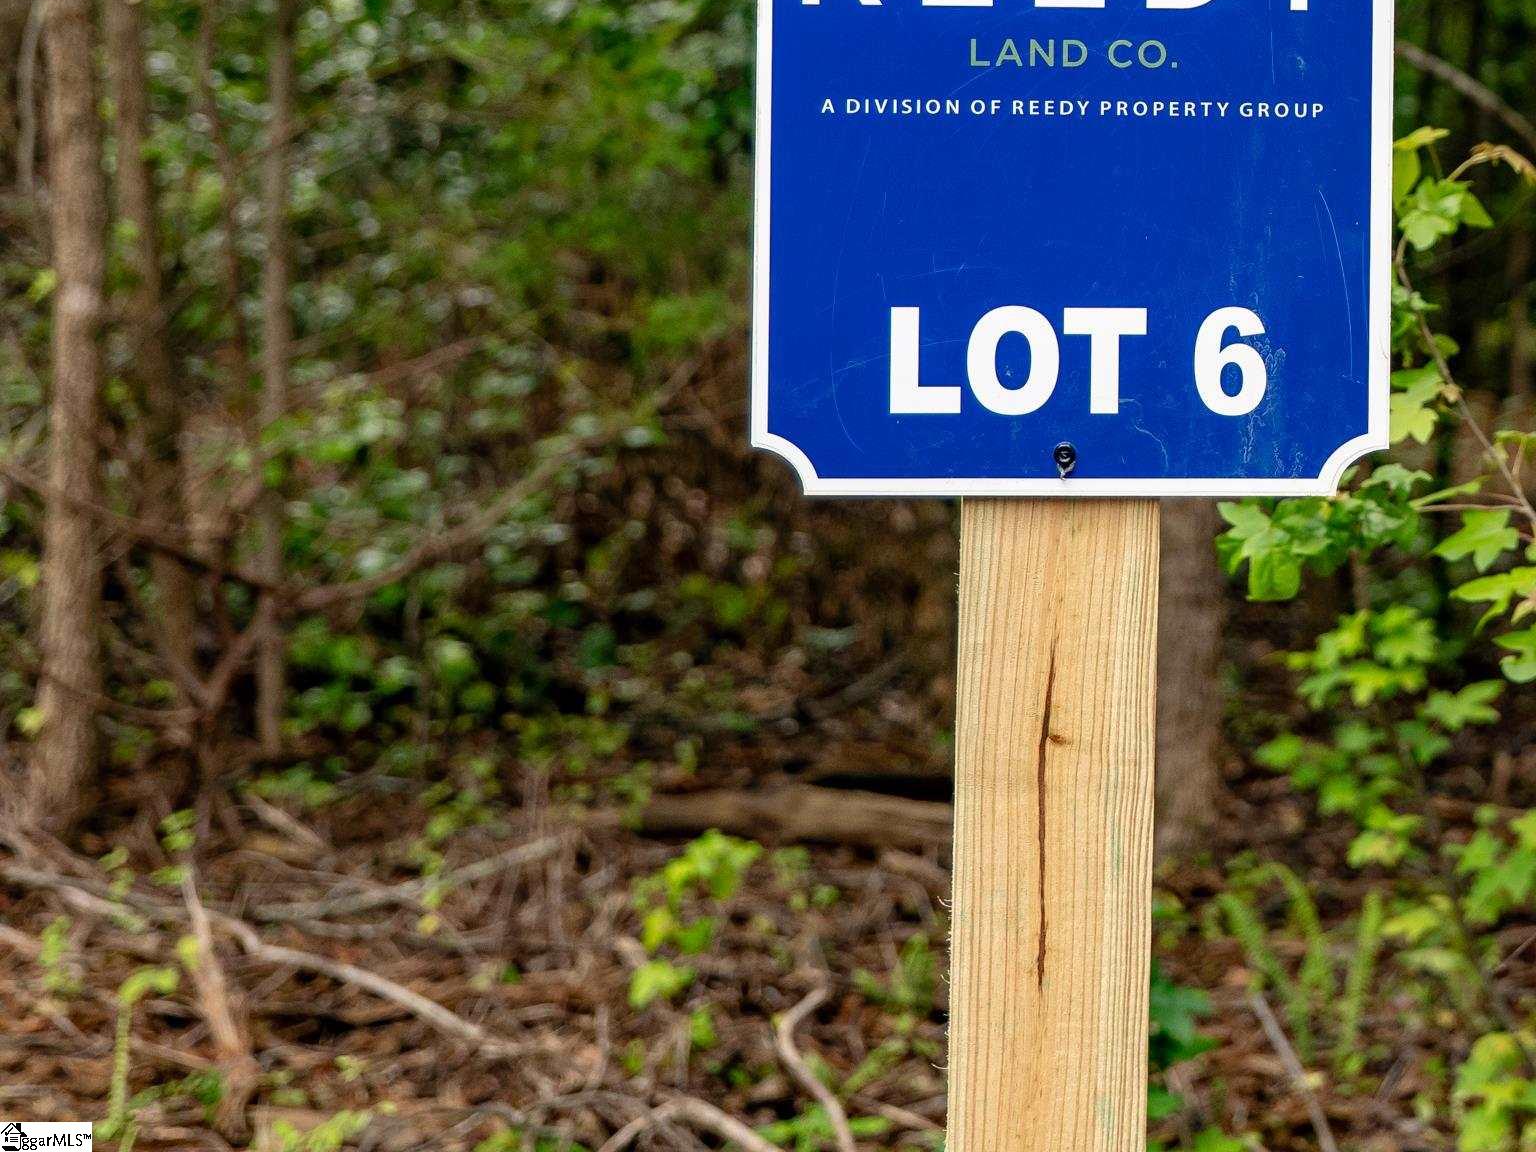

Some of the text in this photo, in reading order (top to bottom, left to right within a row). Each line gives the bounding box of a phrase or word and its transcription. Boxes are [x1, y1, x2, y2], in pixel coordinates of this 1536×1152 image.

[970, 38, 1178, 69] LAND CO.
[821, 98, 1324, 119] A DIVISION OF REEDY PROPERTY GROUP
[889, 305, 1267, 417] LOT 6
